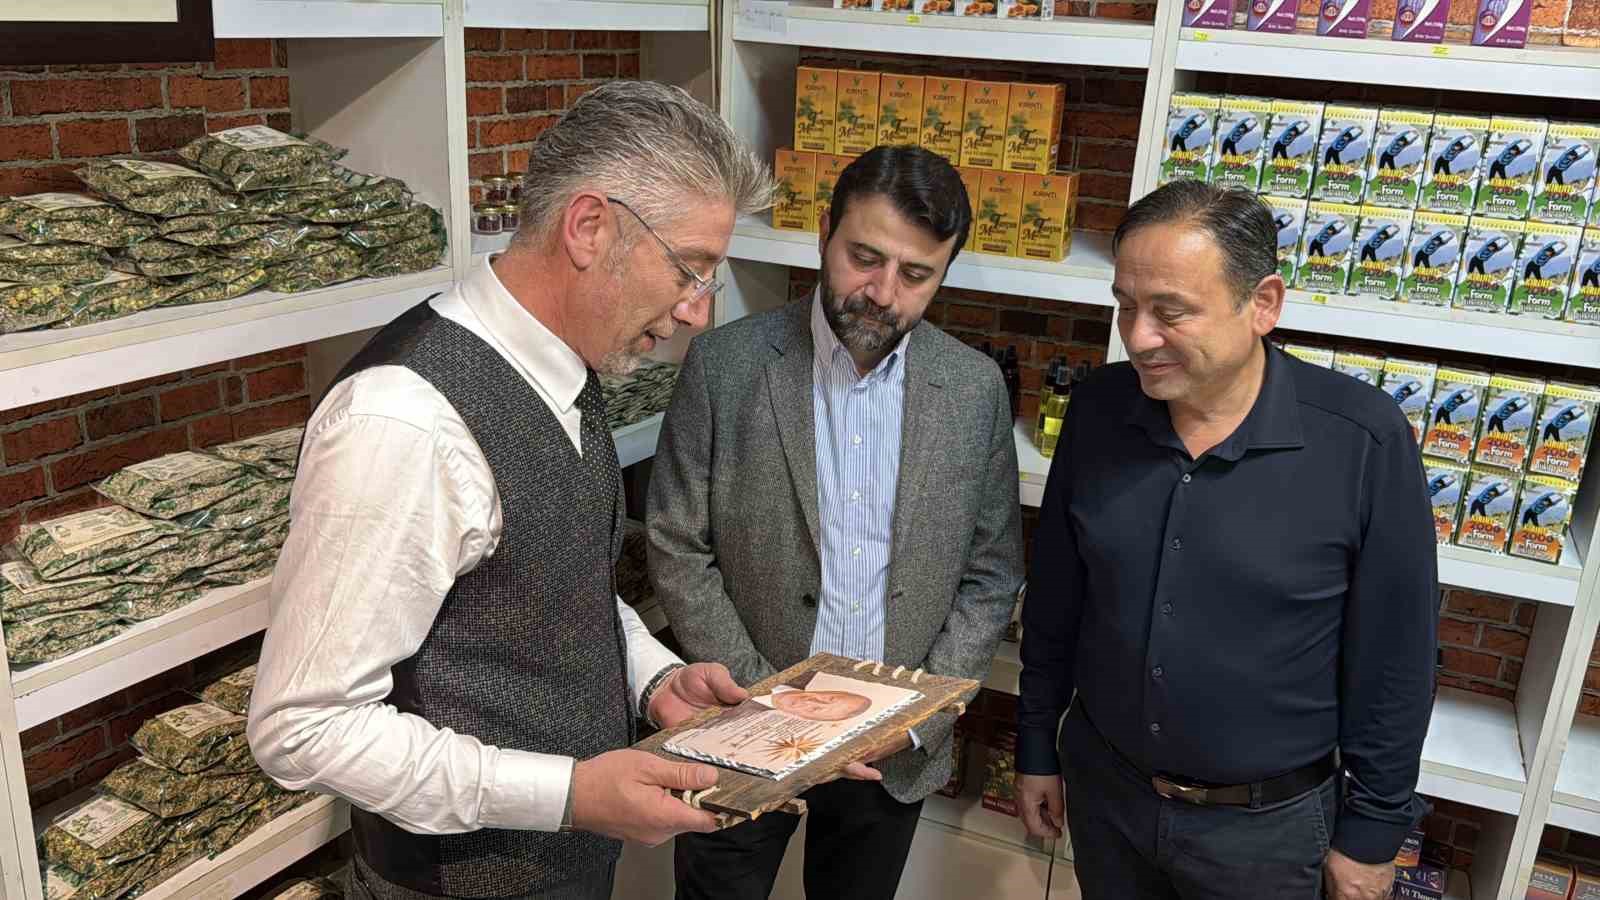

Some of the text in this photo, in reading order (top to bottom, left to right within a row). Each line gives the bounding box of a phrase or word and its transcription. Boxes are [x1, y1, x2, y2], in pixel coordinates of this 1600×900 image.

[1175, 165, 1195, 174] Form
[1225, 171, 1245, 181] Form
[1276, 174, 1296, 185] Form
[1328, 180, 1349, 191] Form
[1382, 185, 1403, 196] Form
[1436, 191, 1459, 202] Form
[1492, 195, 1515, 206] Form
[1548, 201, 1572, 212] Form
[1311, 272, 1332, 282] Form
[1364, 277, 1385, 287] Form
[1416, 283, 1438, 294] Form
[1470, 290, 1493, 301] Form
[1528, 295, 1550, 306] Form
[1438, 438, 1459, 449] Form
[1491, 446, 1513, 457] Form
[1546, 455, 1569, 466] Form
[1473, 530, 1494, 540] Form
[1525, 539, 1546, 550] Form
